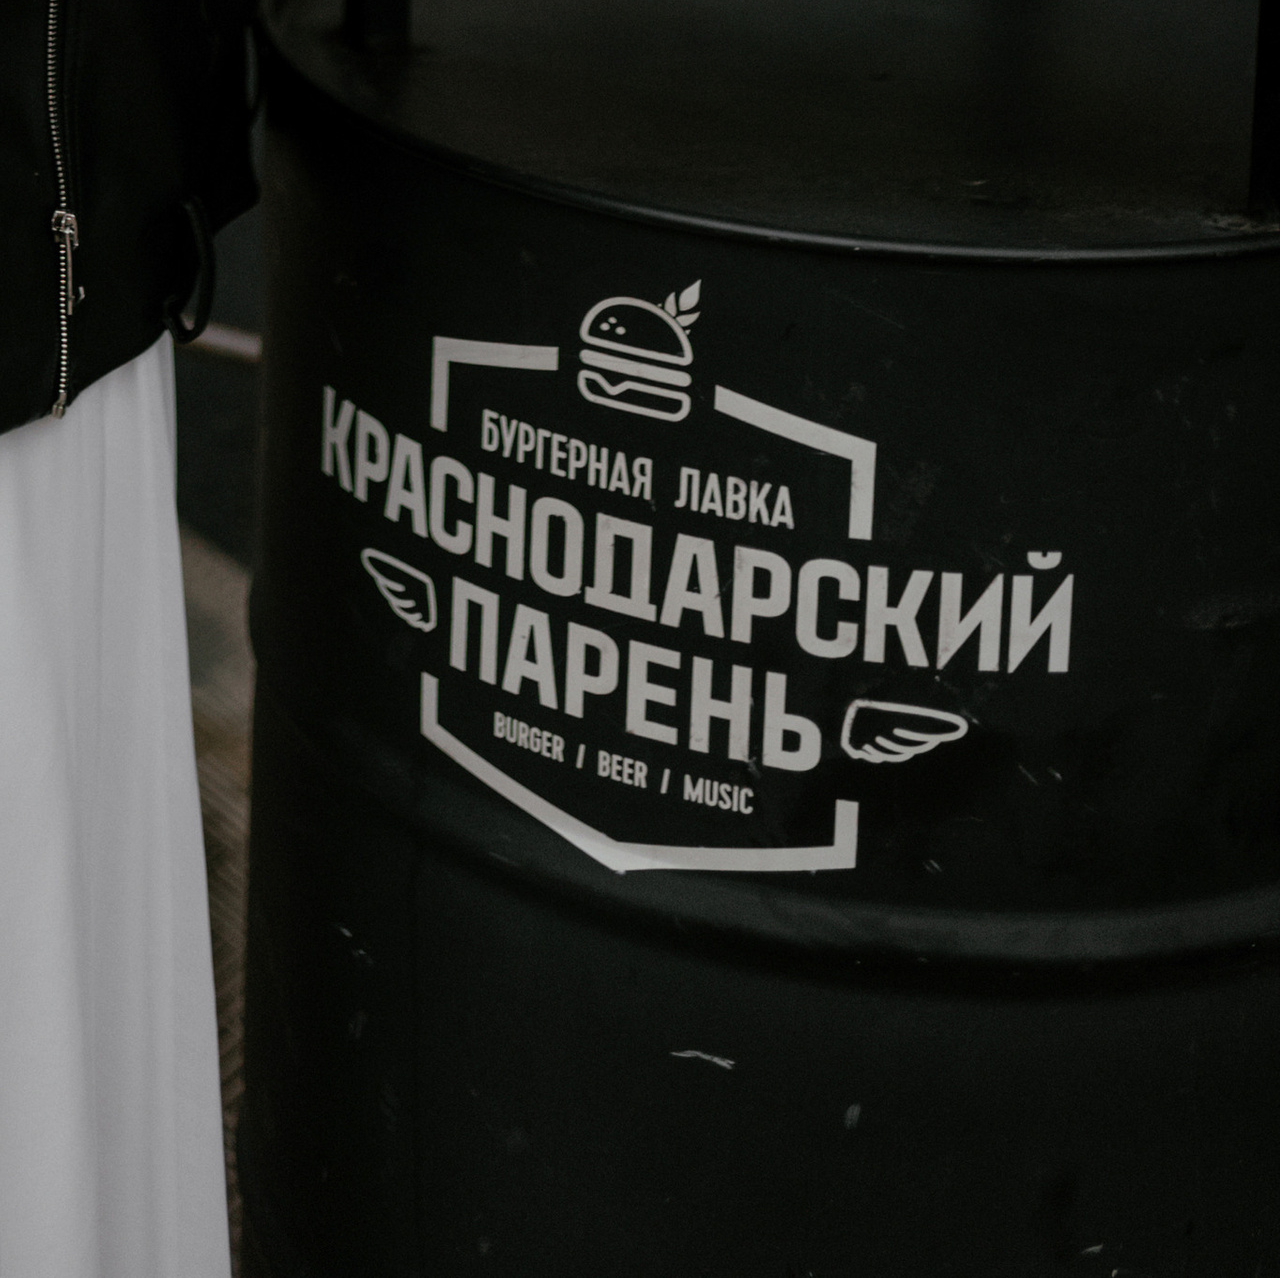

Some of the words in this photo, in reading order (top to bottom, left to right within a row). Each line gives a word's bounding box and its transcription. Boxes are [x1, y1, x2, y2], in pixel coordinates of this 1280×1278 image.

[321, 384, 1074, 675] КРАСНОДАРСКИЙ
[481, 408, 653, 500] БУРГЕРНАЯ
[675, 467, 795, 530] ЛАВКА
[449, 575, 822, 772] ПАРЕНЬ
[492, 710, 565, 763] BURGER
[597, 750, 648, 790] BEER
[682, 773, 755, 815] MUSIC
